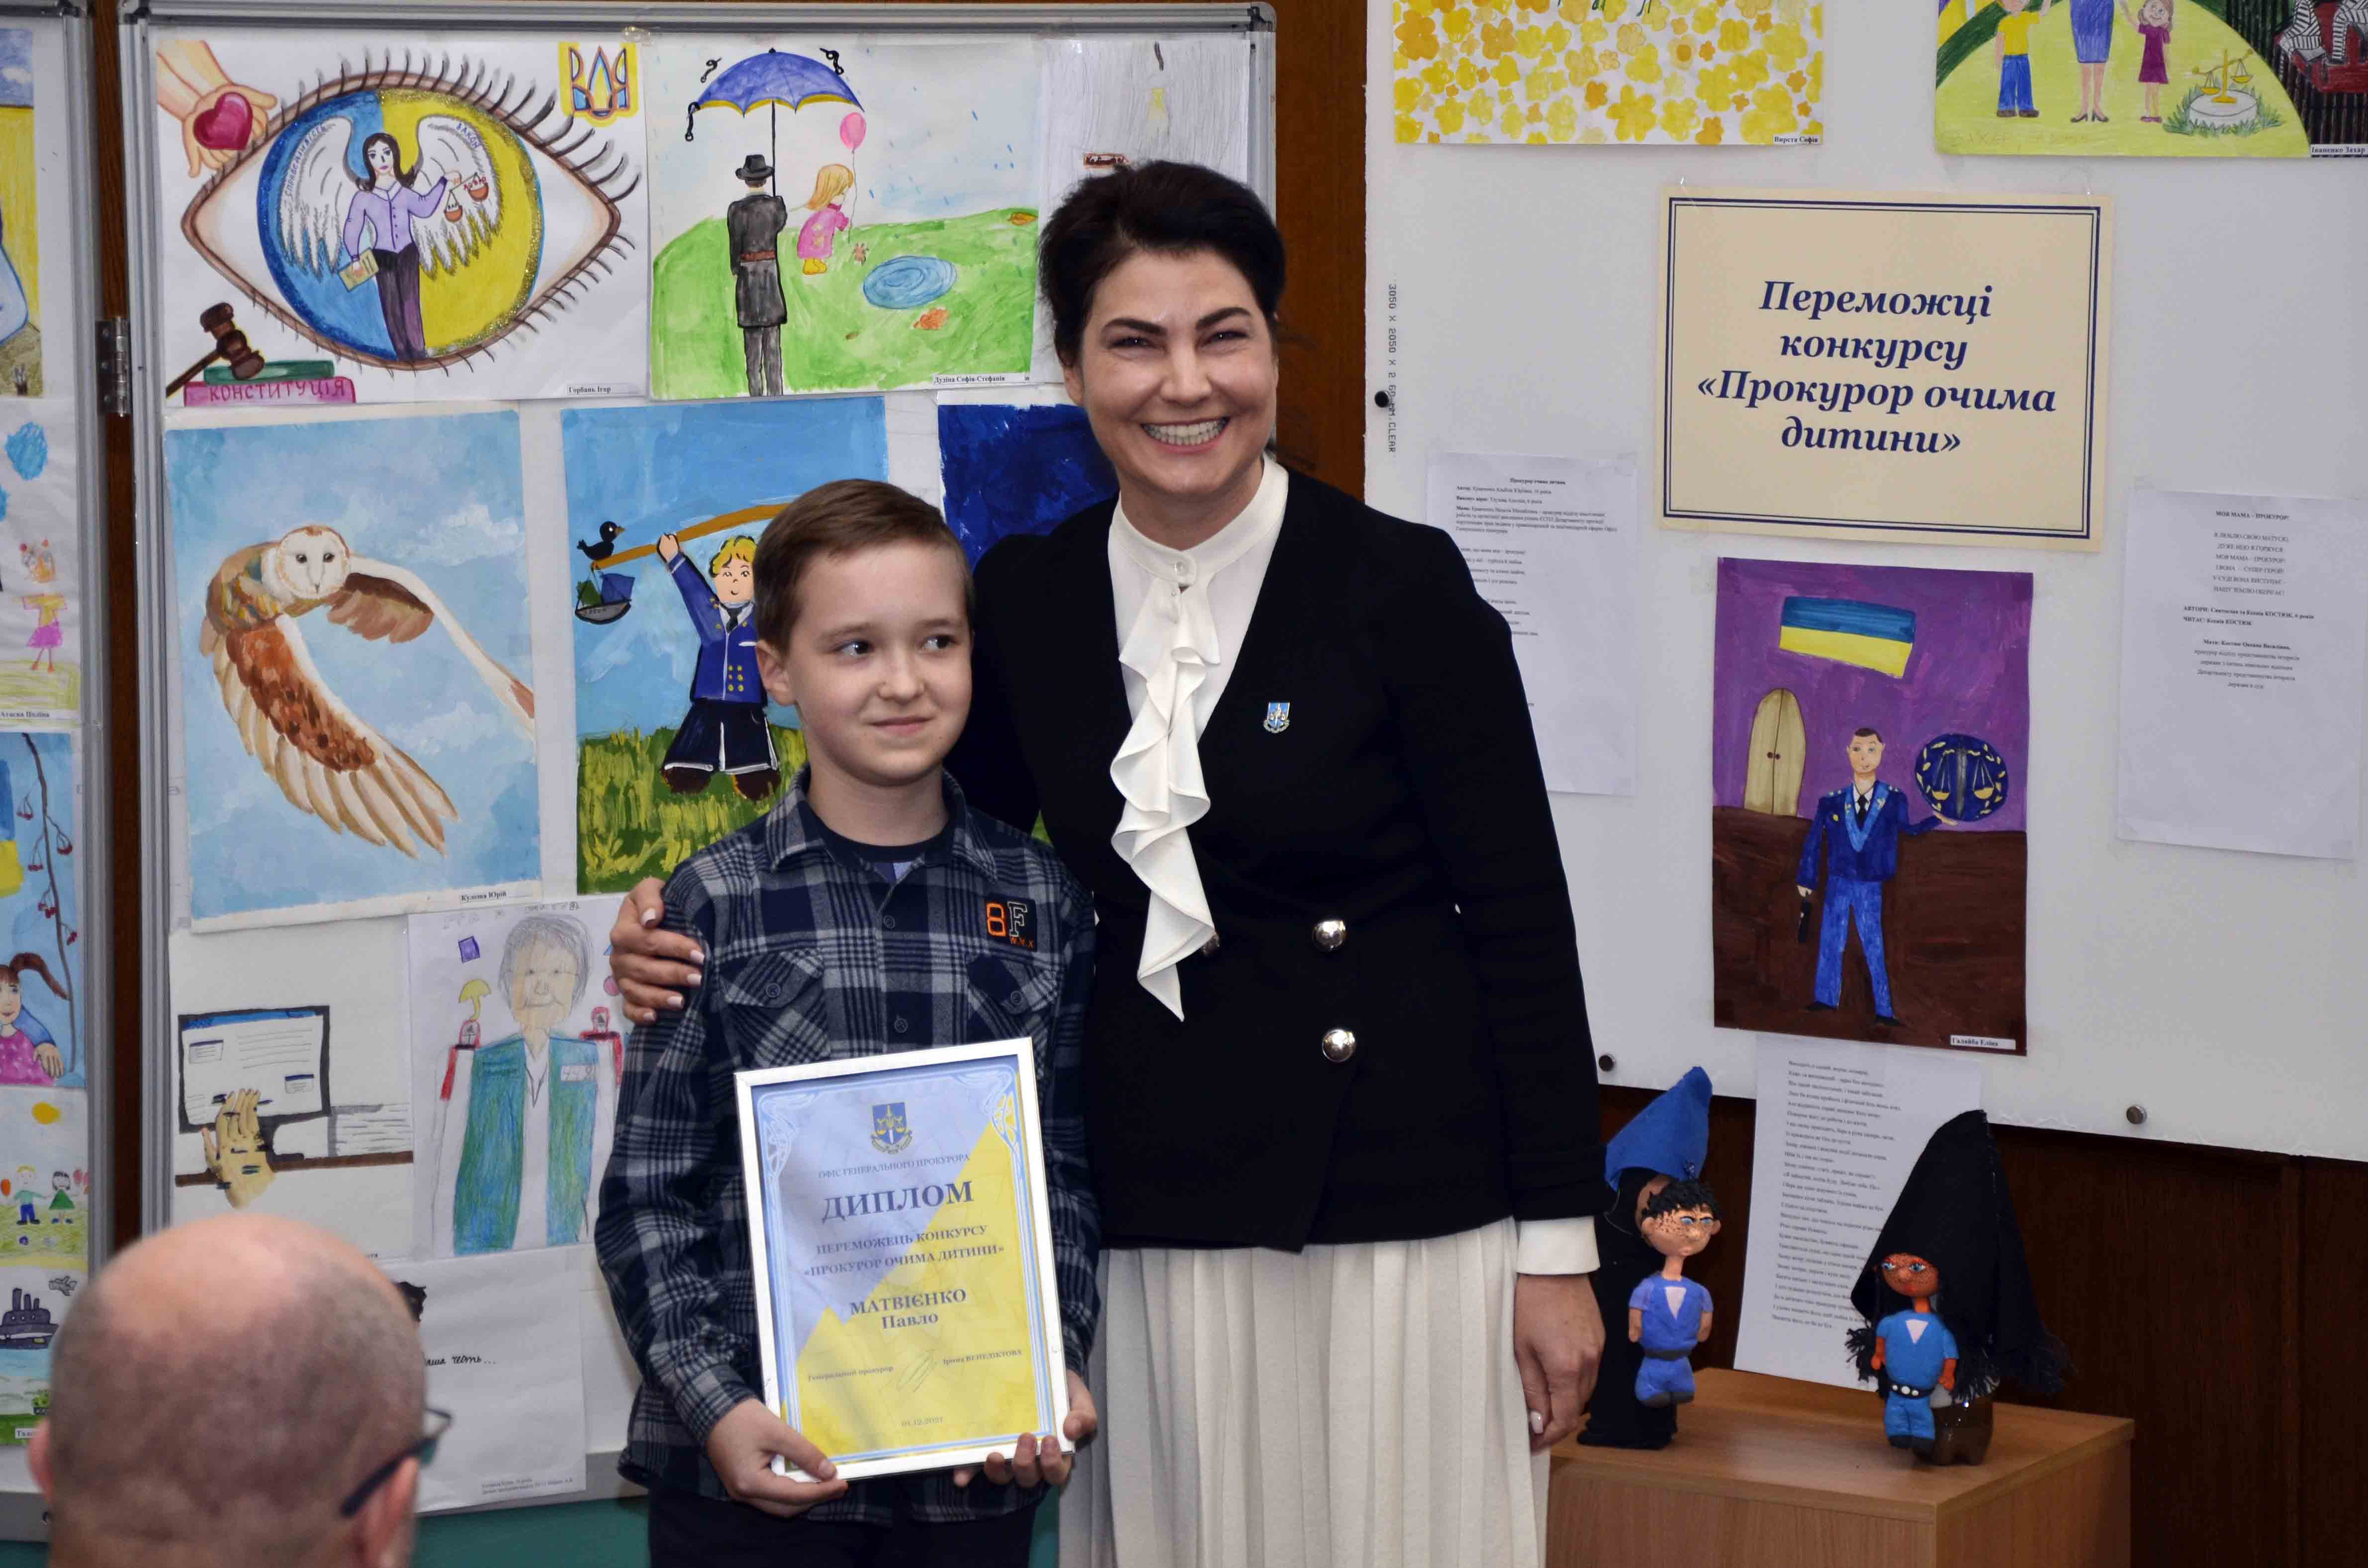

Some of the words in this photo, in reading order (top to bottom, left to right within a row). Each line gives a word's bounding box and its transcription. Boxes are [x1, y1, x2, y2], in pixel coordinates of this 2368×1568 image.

[456, 123, 481, 148] ЗАКОН
[1799, 136, 1819, 144] Софія
[1388, 284, 1397, 309] 3050
[1759, 281, 1993, 324] Переможці
[1388, 328, 1397, 353] 2050
[1780, 335, 1968, 370] конкурсу
[210, 378, 346, 402] КОНСТИТУЦІЯ
[1698, 370, 1913, 414] «Прокурор
[1924, 385, 2056, 412] очима
[1782, 416, 1961, 453] дитини»
[488, 891, 507, 900] Юрій
[819, 1169, 842, 1179] ОФІС
[843, 1162, 914, 1176] ГЕНЕРАЛЬНОГО
[916, 1154, 971, 1168] ПРОКУРОРА
[821, 1181, 974, 1224] ДИПЛОМ
[817, 1234, 913, 1255] ПЕРЕМОЖЕЦЬ
[916, 1224, 988, 1242] КОНКУРСУ
[804, 1258, 883, 1277] «ПРОКУРОР
[885, 1251, 936, 1267] ОЧИМА
[938, 1244, 1004, 1261] ДИТИНИ»
[850, 1289, 967, 1315] МАТВІЄНКО
[882, 1313, 939, 1329] Павло
